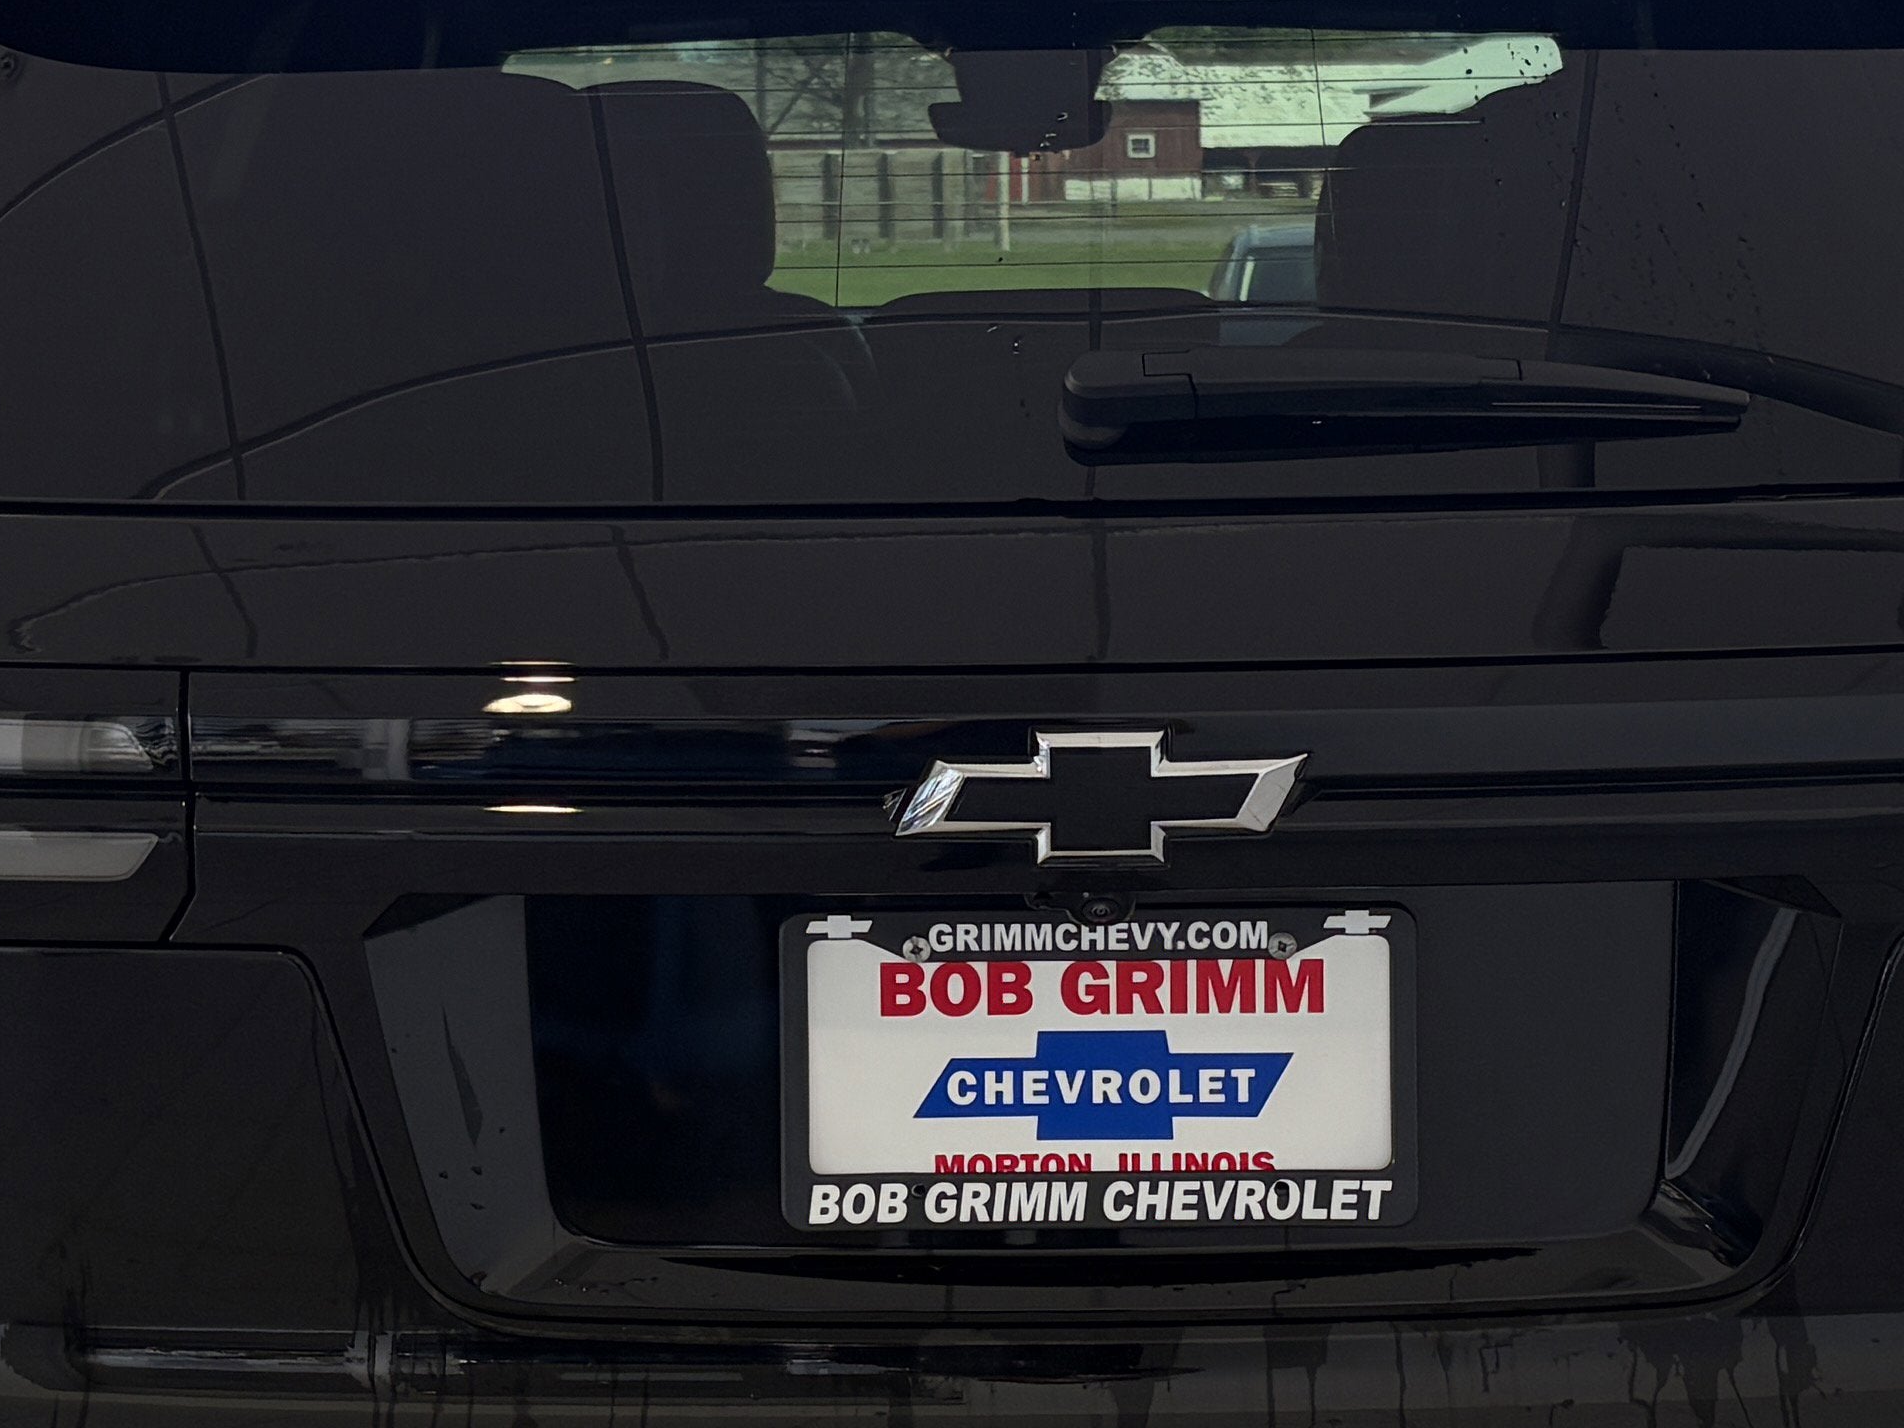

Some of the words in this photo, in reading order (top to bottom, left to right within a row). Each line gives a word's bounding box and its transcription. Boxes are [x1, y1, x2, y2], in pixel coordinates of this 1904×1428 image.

[927, 920, 1269, 953] GRIMMCHEVY.COM
[879, 961, 1033, 1017] BOB
[1060, 958, 1324, 1015] GRIMM
[946, 1068, 1256, 1105] CHEVROLET
[808, 1182, 908, 1225] BOB
[924, 1180, 1088, 1224] GRIMM
[1102, 1178, 1393, 1222] CHEVROLET
